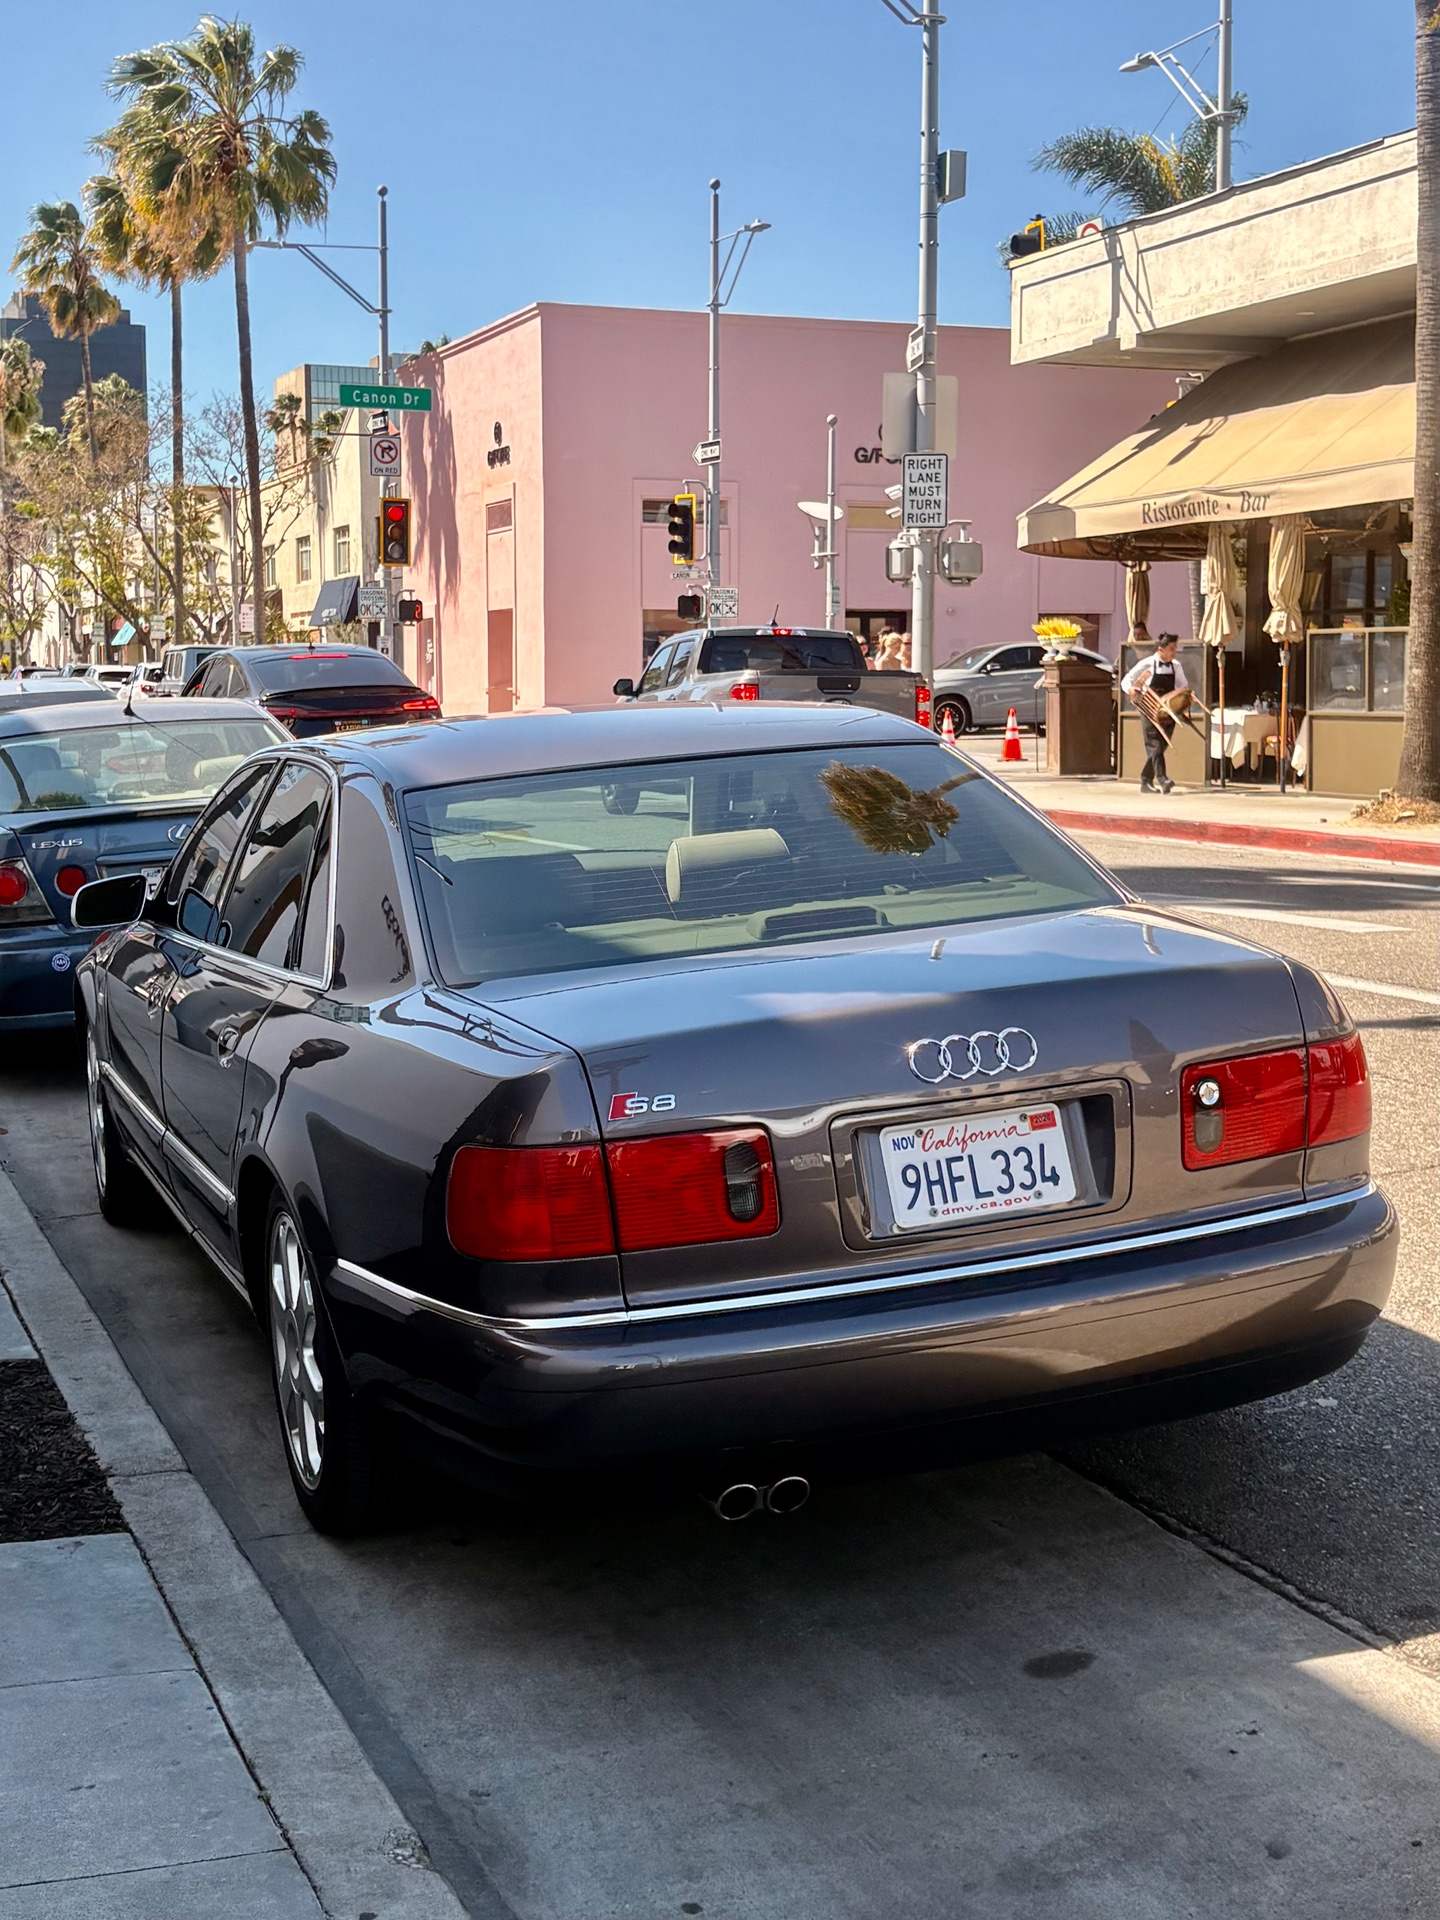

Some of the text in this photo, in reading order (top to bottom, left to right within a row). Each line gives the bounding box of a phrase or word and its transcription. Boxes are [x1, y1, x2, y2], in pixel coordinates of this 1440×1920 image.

[352, 389, 419, 406] Canon Dr
[907, 459, 943, 470] RIGHT
[909, 472, 941, 483] LANE
[908, 486, 942, 497] MUST
[908, 499, 942, 510] TURN
[1141, 490, 1270, 525] Ristorante Bar
[907, 512, 943, 523] RIGHT
[360, 603, 373, 616] OK
[710, 602, 722, 615] OK
[31, 838, 83, 849] LEXUS
[623, 1093, 677, 1115] S8
[891, 1135, 915, 1152] NOV
[921, 1119, 1031, 1154] California
[900, 1142, 1061, 1210] 9HFL334
[941, 1194, 1032, 1216] dmv.ca.gov
